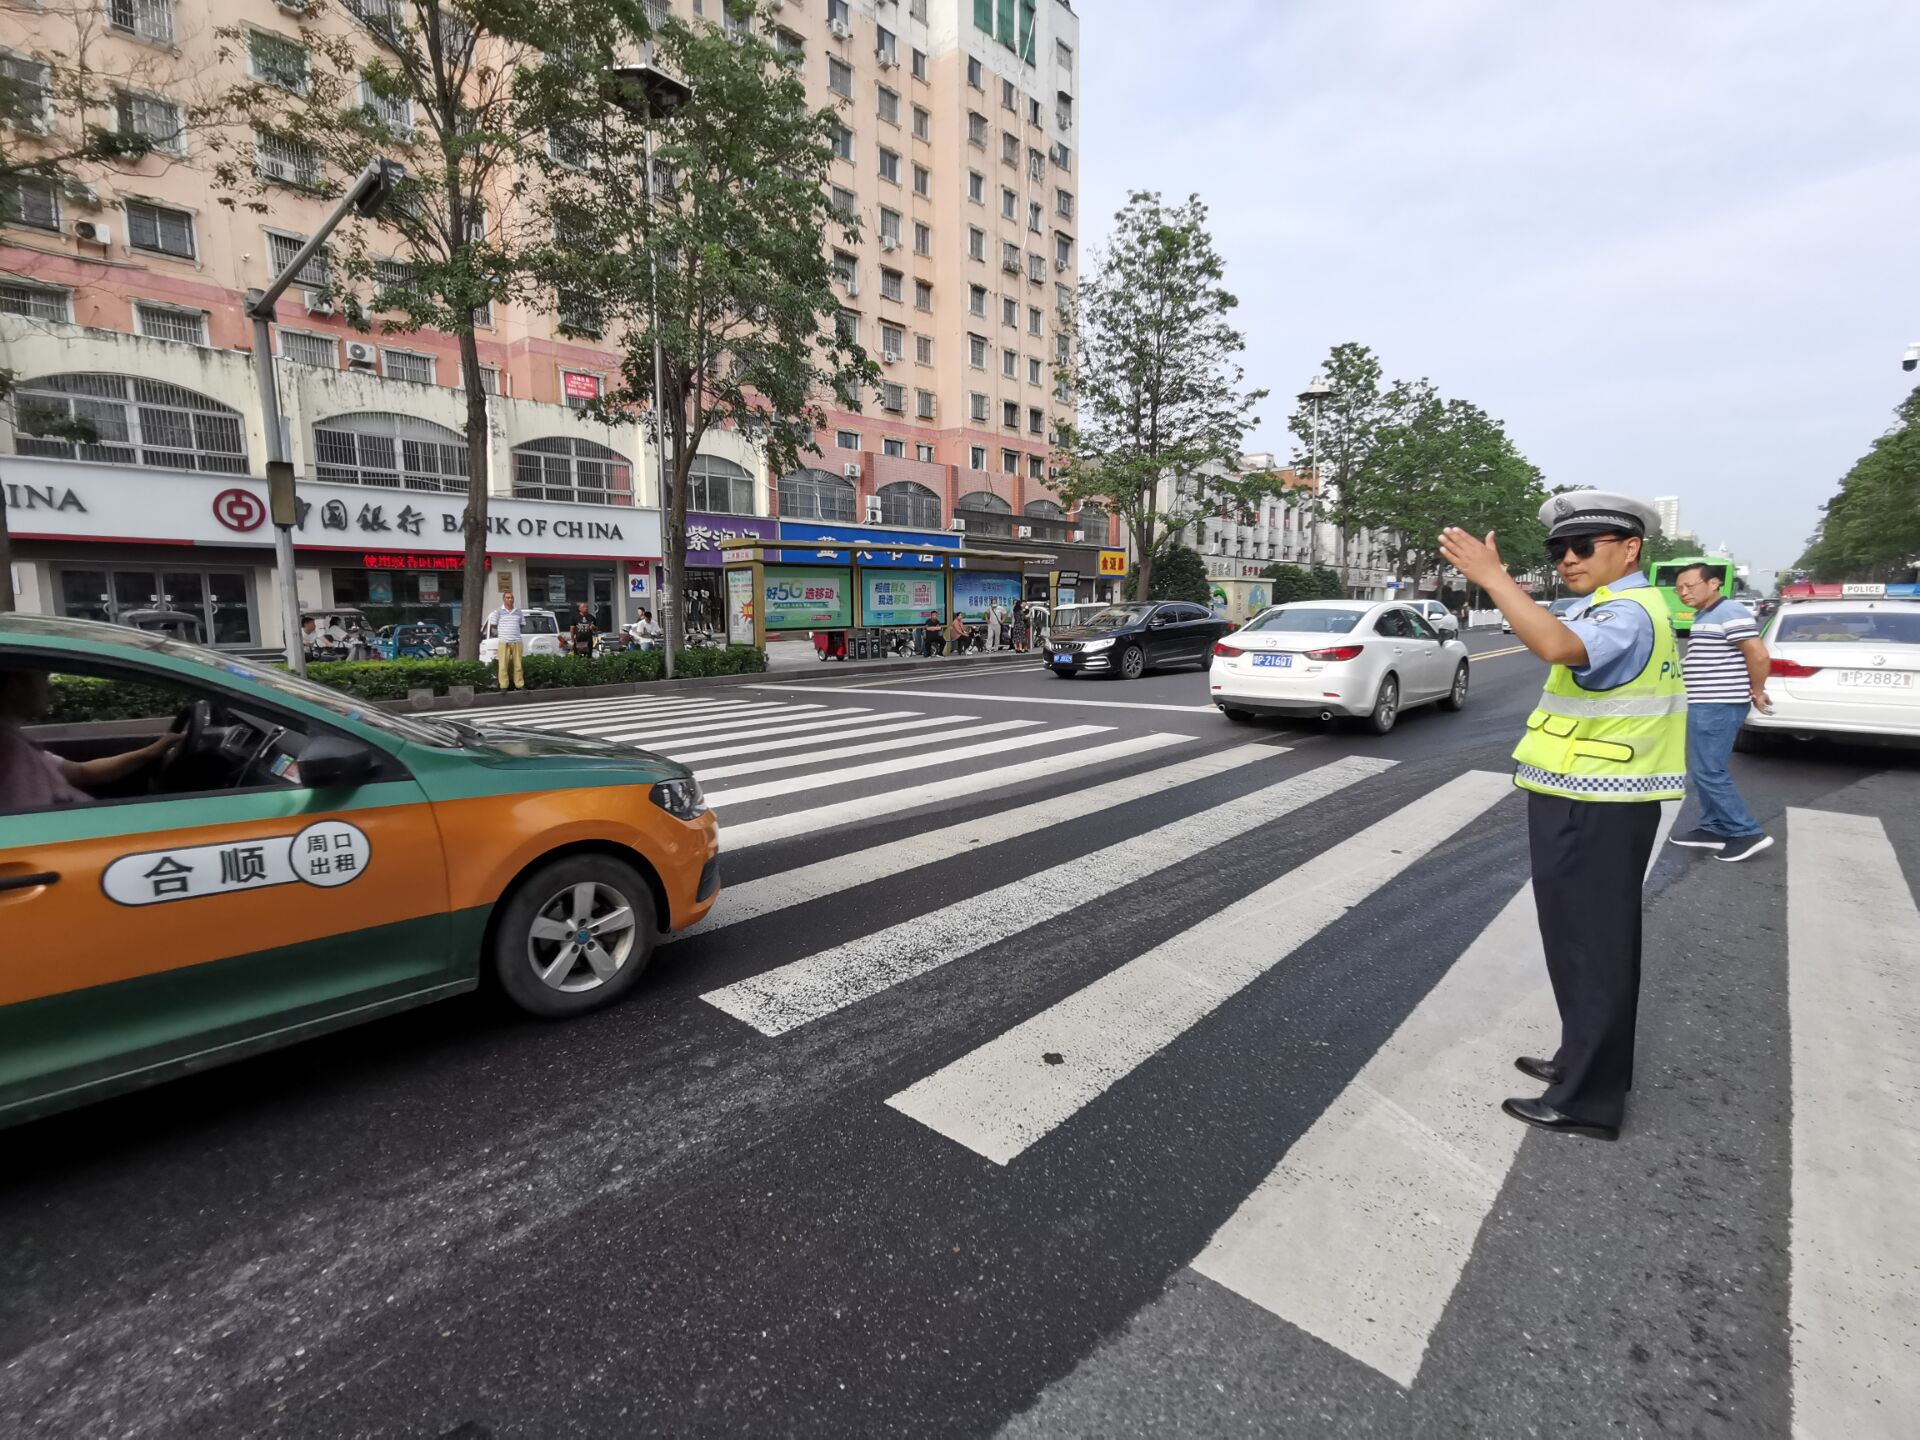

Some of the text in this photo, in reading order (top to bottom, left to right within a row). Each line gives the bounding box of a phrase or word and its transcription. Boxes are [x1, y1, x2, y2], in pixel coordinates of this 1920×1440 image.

[6, 483, 88, 513] INA
[442, 514, 624, 541] BK OF CHINA
[1847, 585, 1881, 593] POLICE
[1659, 661, 1682, 681] POL
[307, 833, 352, 853] 周口
[143, 846, 267, 896] 合顺
[310, 854, 356, 877] 出租
